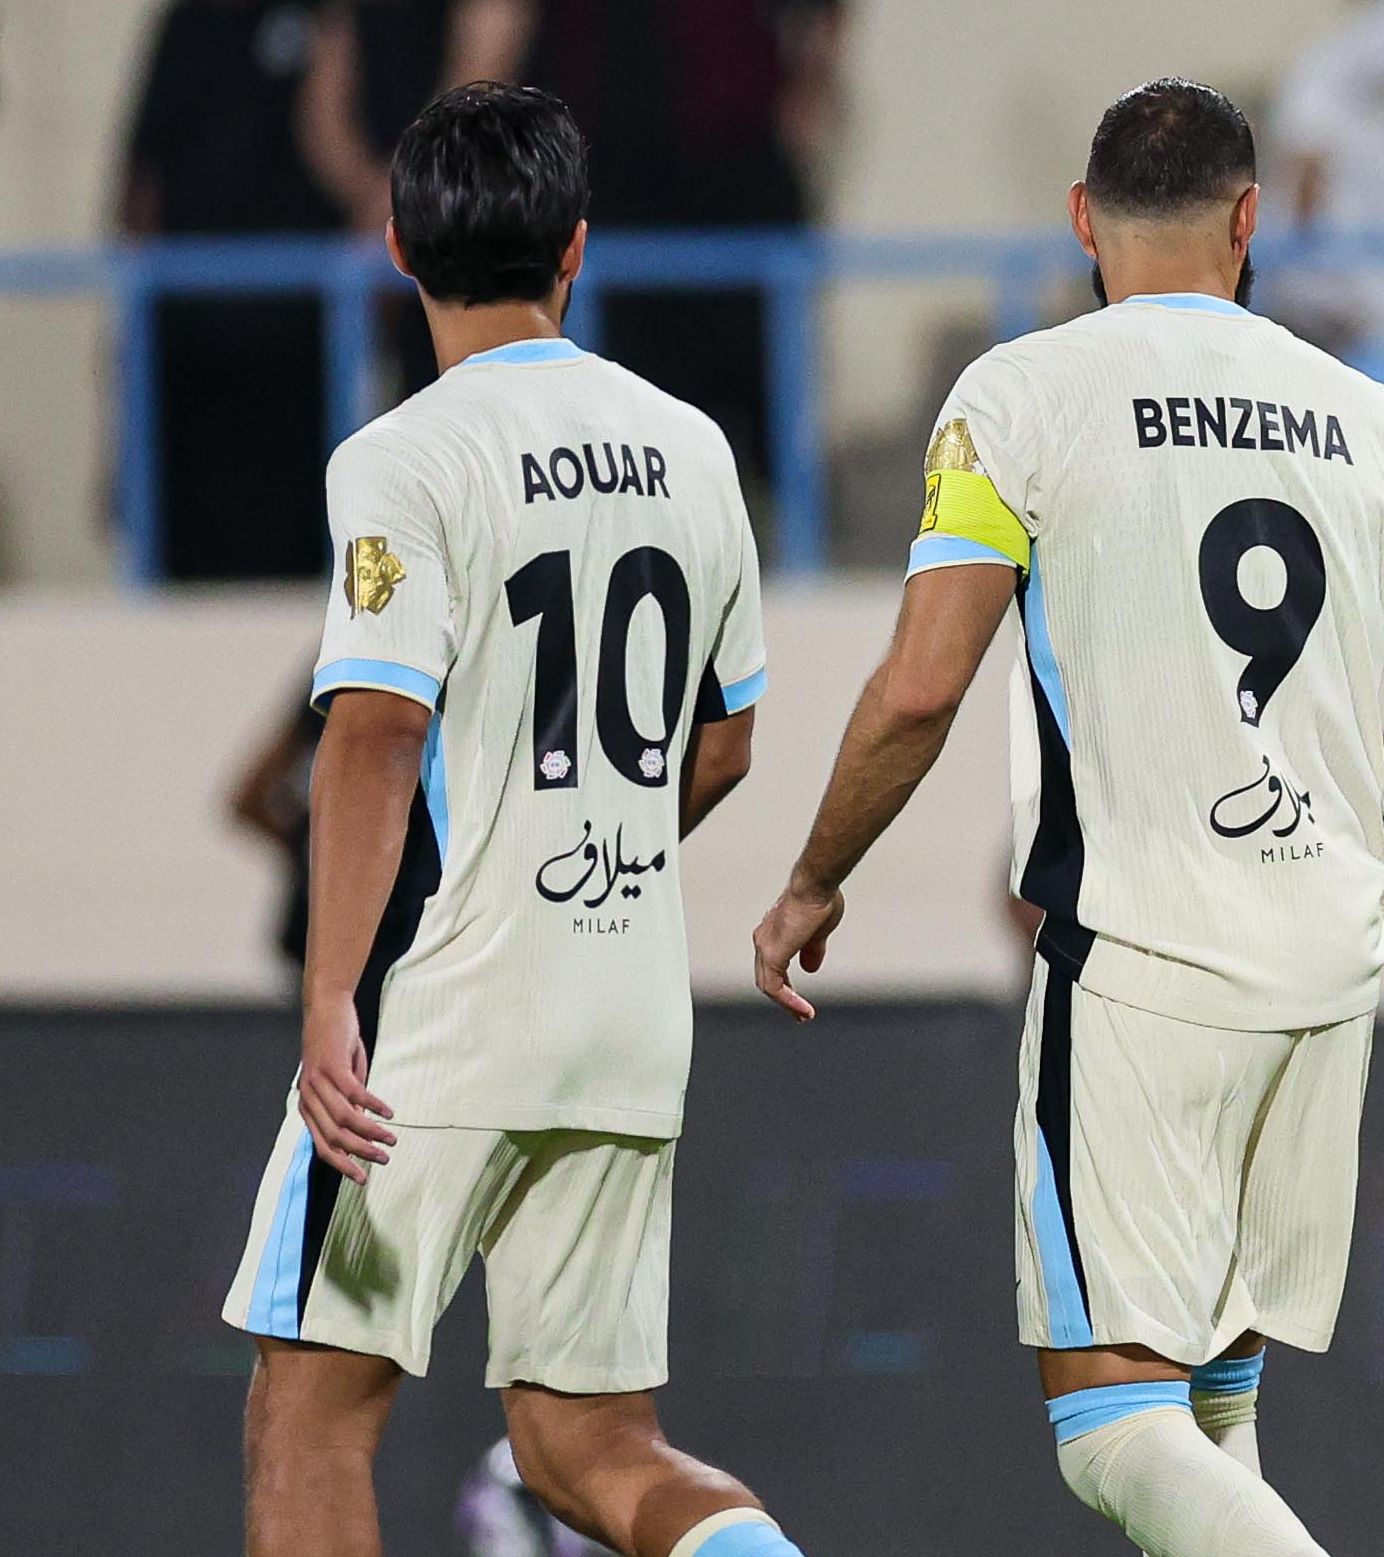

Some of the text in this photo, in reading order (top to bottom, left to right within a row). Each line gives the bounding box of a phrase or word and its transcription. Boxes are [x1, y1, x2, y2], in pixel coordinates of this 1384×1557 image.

[1131, 396, 1355, 466] BENZEMA
[520, 442, 671, 505] AOUAR
[1198, 497, 1327, 728] 9
[503, 545, 692, 791] 10
[1260, 842, 1324, 864] MILAF
[572, 917, 631, 935] MILAF
